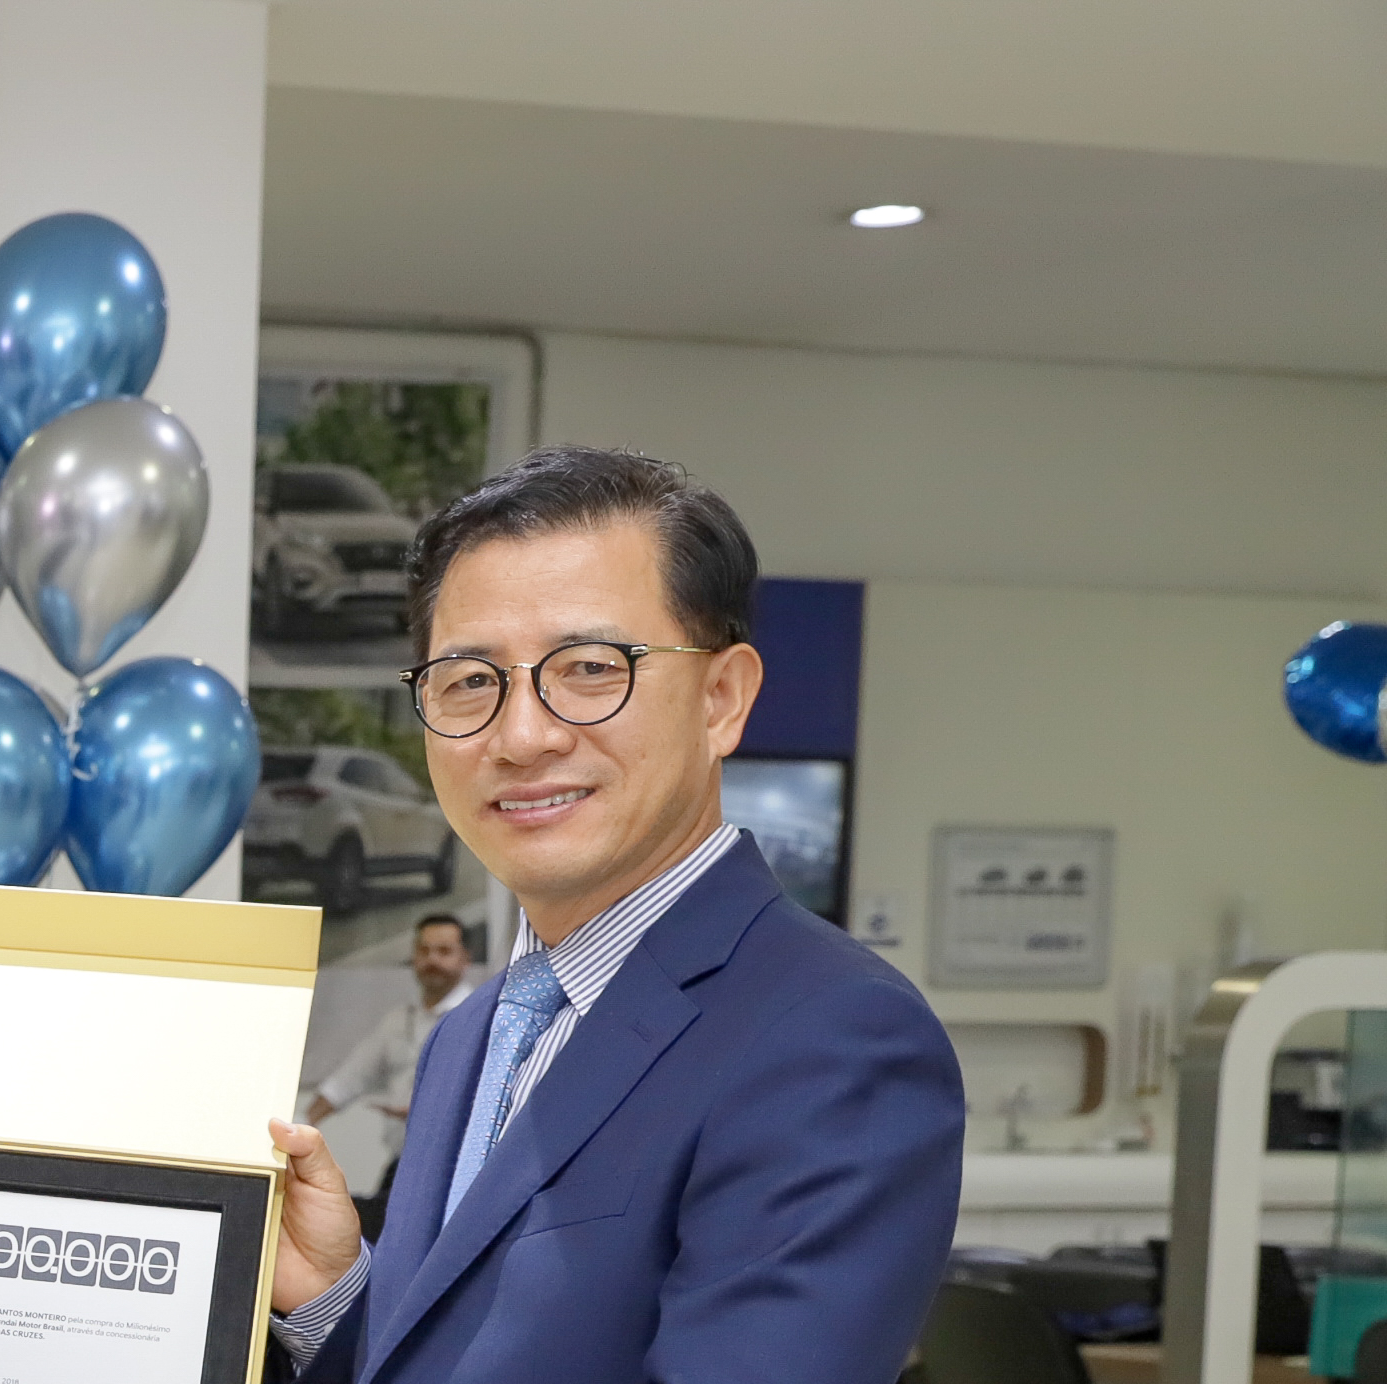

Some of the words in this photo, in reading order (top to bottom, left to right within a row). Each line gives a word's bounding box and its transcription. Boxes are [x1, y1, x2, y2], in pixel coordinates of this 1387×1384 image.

[18, 1320, 41, 1329] Motor
[43, 1323, 65, 1333] Brasil,
[67, 1327, 93, 1335] através
[105, 1331, 161, 1342] concessionária
[24, 1311, 67, 1322] MONTEIRO
[67, 1316, 84, 1324] pela
[85, 1319, 113, 1328] compra
[126, 1321, 171, 1333] Milionésimo
[12, 1330, 45, 1340] CRUZES.
